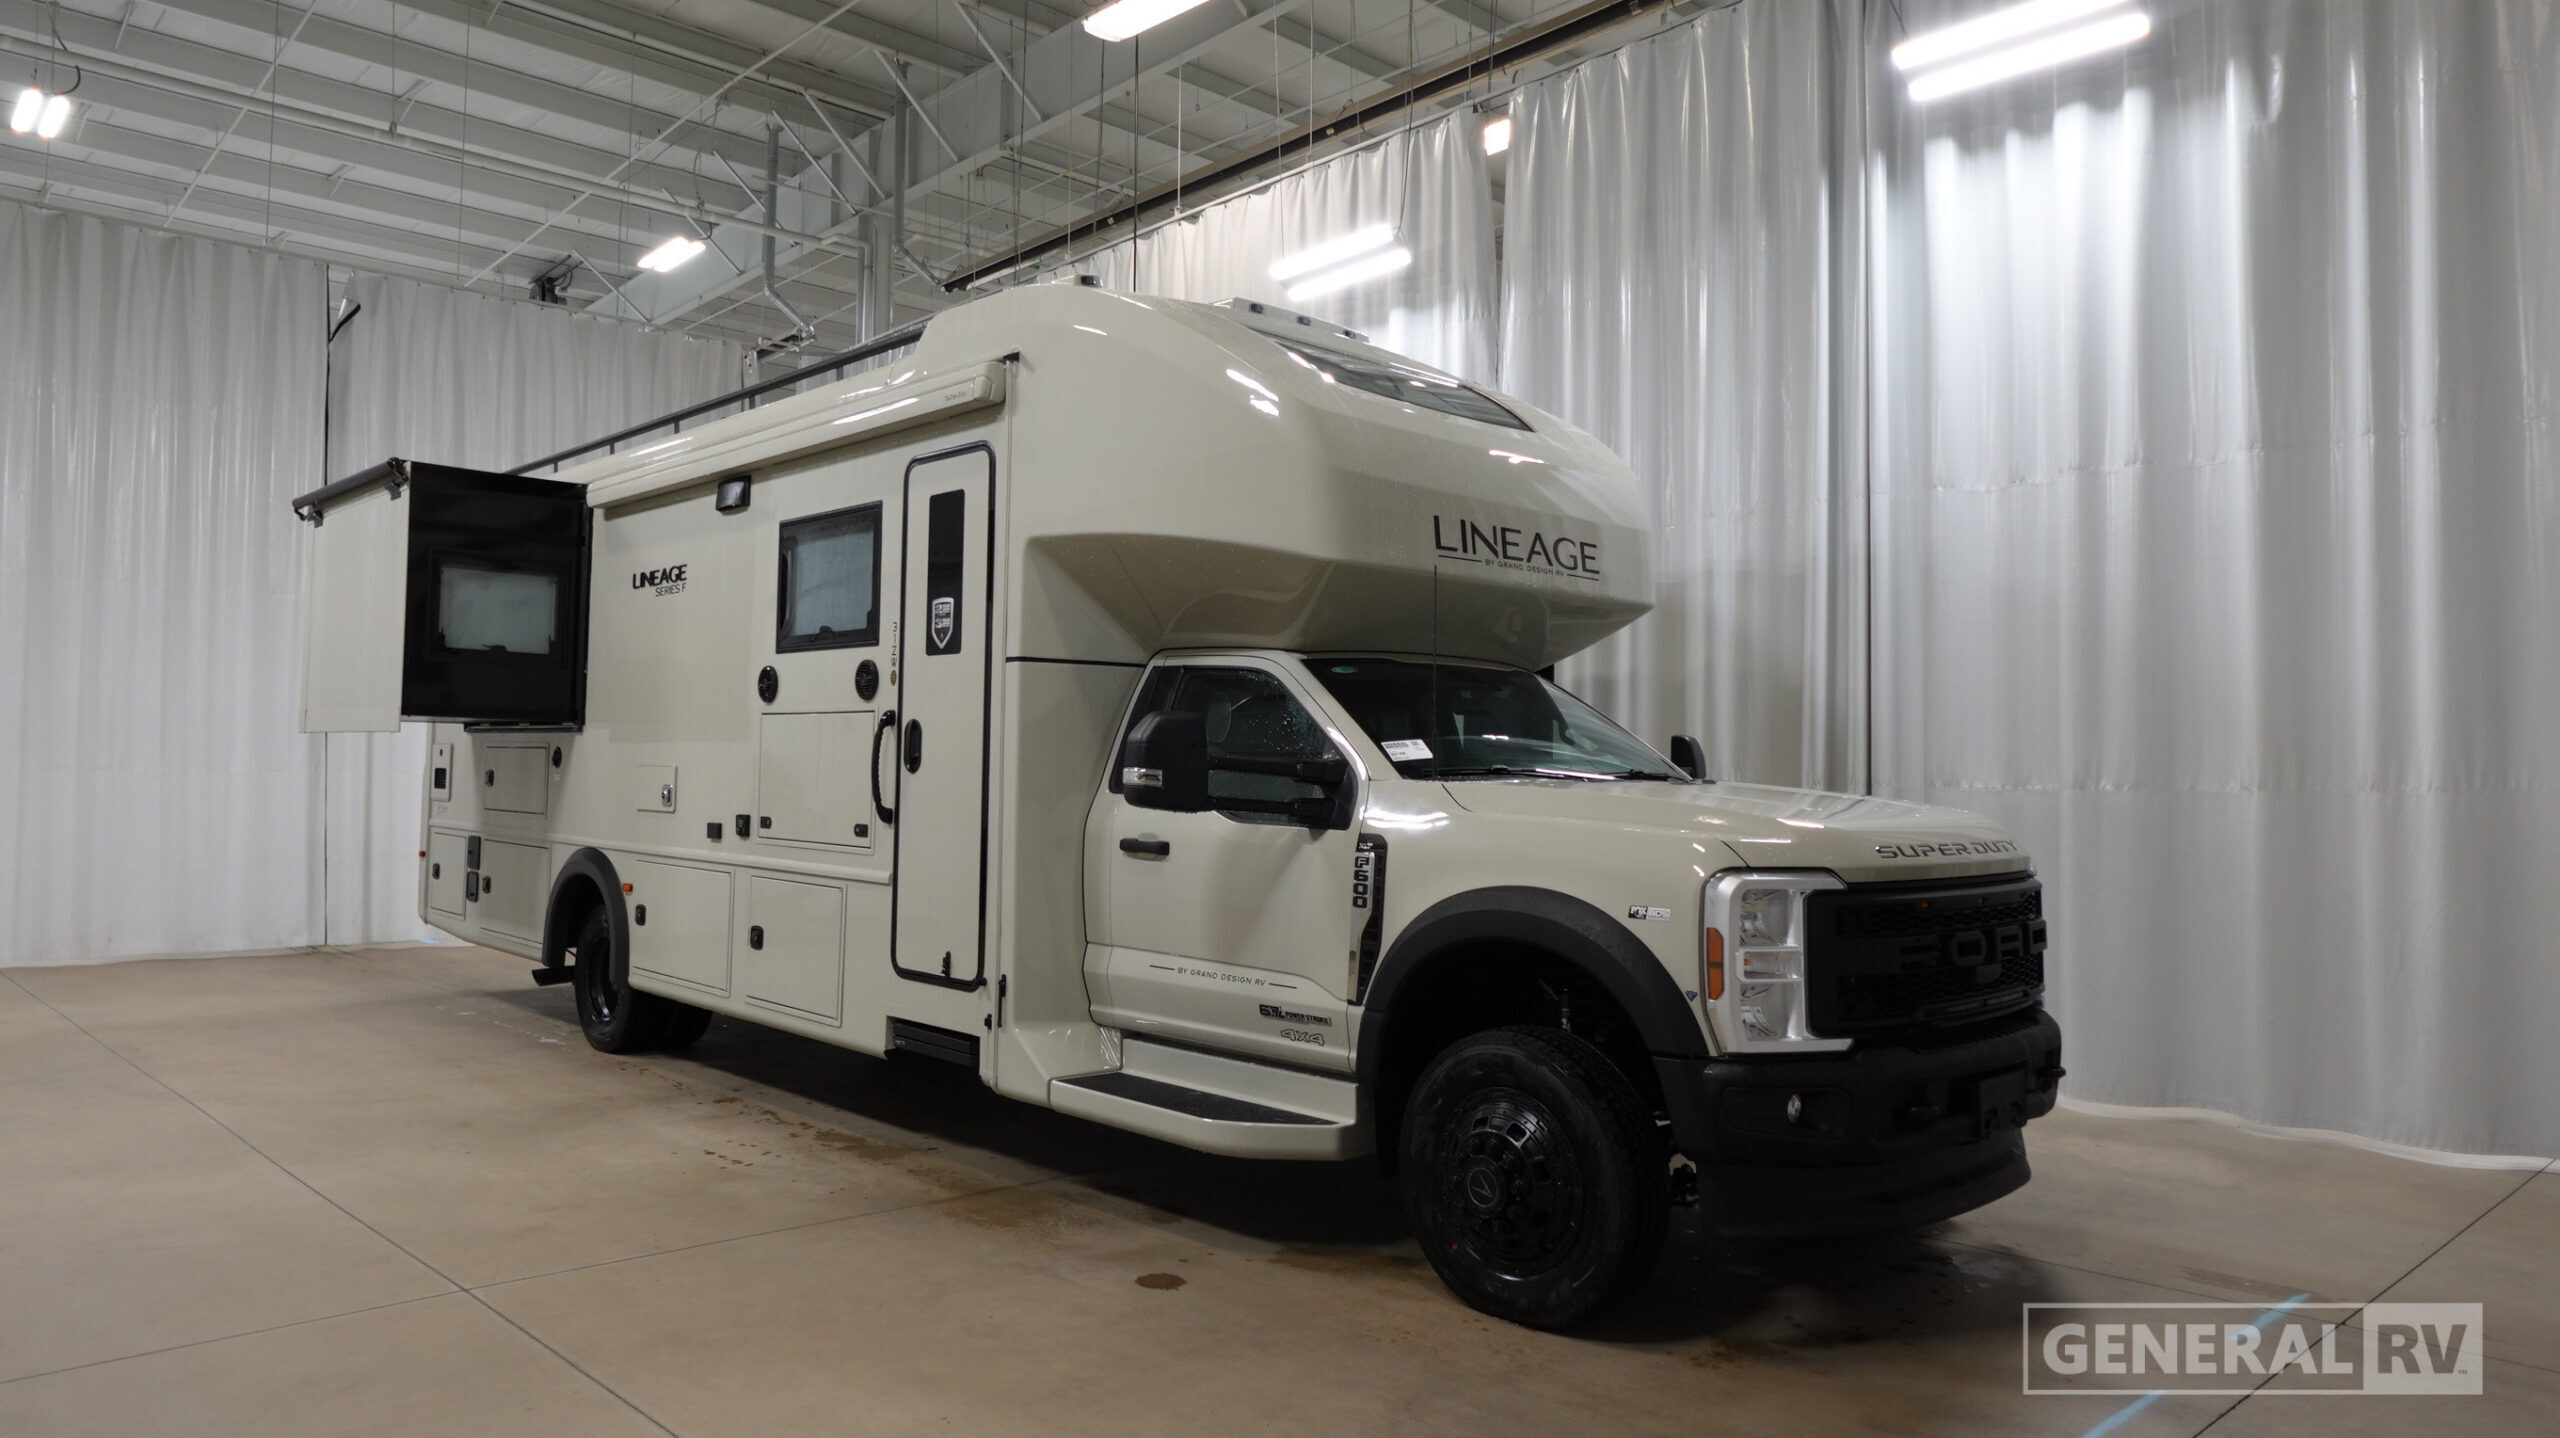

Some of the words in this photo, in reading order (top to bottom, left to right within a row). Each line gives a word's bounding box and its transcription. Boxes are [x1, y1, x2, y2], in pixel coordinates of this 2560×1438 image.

[1433, 515, 1600, 575] LINEAGE
[632, 564, 687, 590] LINEAGE
[1484, 559, 1495, 567] BY
[1497, 561, 1524, 572] GRAND
[1526, 564, 1554, 576] DESIGN
[1555, 569, 1564, 577] RV
[655, 584, 680, 597] SERIES
[681, 582, 687, 592] F
[1875, 843, 1969, 859] SUPER
[1970, 840, 2018, 855] DUTY
[1352, 856, 1370, 909] F600
[1630, 906, 1648, 918] FOX
[1177, 966, 1187, 974] BY
[1190, 968, 1218, 980] GRAND
[1220, 973, 1252, 984] DESIGN
[1254, 978, 1266, 987] RV
